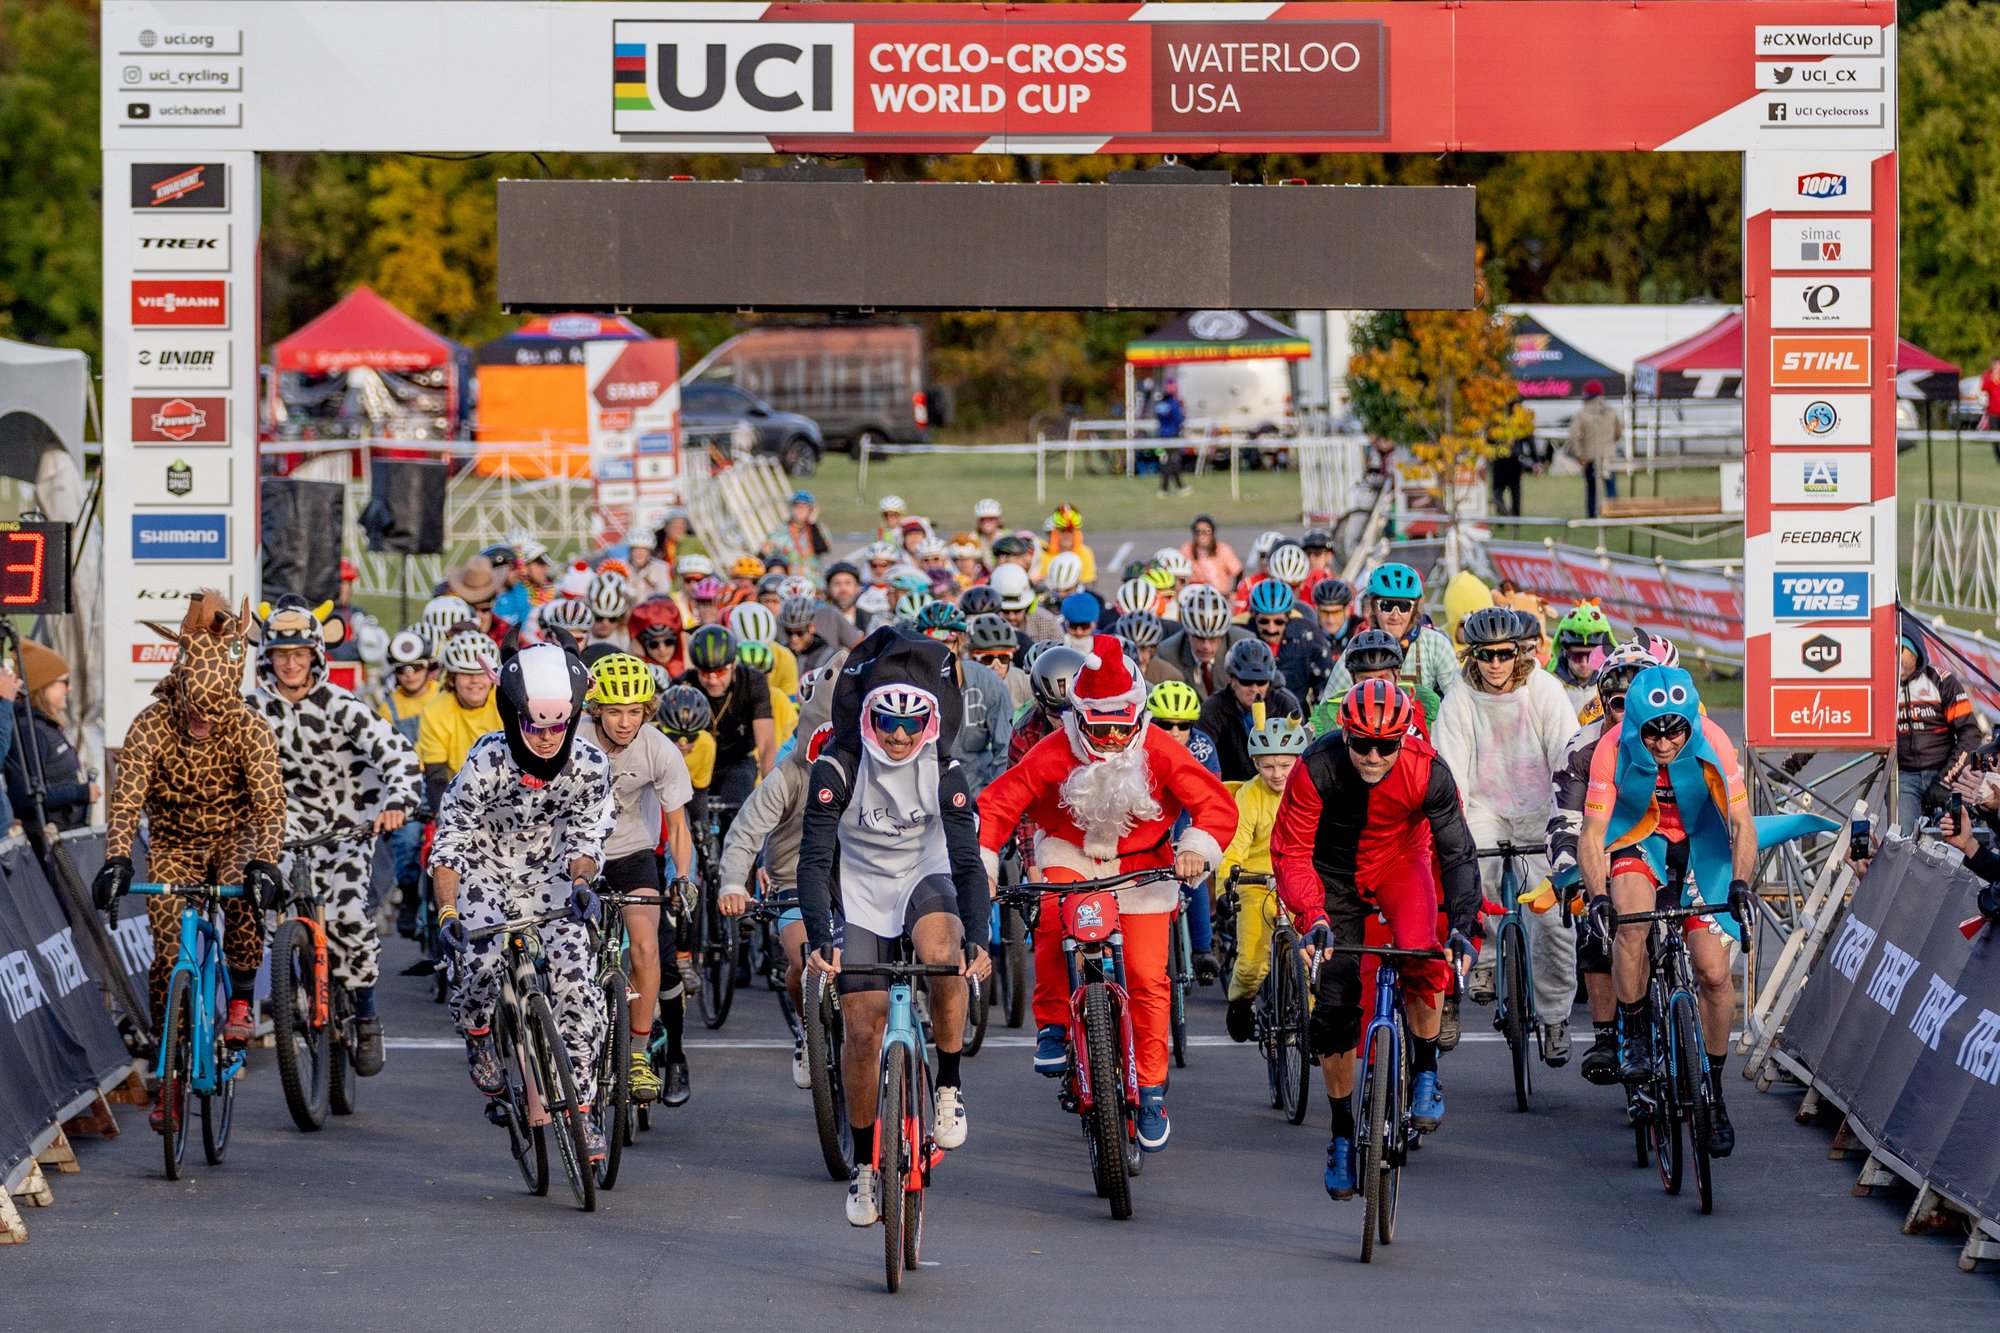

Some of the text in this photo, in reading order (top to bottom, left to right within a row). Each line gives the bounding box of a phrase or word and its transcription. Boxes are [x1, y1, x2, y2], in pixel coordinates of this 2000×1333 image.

[164, 32, 214, 48] uci.org
[1763, 32, 1873, 49] #CXWorldCup
[869, 43, 1127, 73] CYCLO-CROSS
[1168, 42, 1361, 72] WATERLOO
[149, 68, 229, 84] uci_cycling
[657, 43, 833, 112] UCI
[1802, 69, 1857, 85] UCI_CX
[870, 83, 1091, 113] WORLD CUP
[1170, 83, 1241, 113] USA
[159, 105, 226, 116] ucichannel
[1795, 106, 1869, 119] UCI Cyclocross
[1801, 176, 1844, 195] 100%
[1801, 227, 1841, 240] simac
[139, 237, 218, 249] TREK
[159, 351, 215, 365] UNIOR
[1781, 352, 1860, 371] STIHL
[139, 530, 219, 544] SHIMANO
[1780, 531, 1862, 544] FEEDBACK
[3, 533, 45, 604] 3
[1782, 578, 1844, 594] TOYO
[1792, 595, 1859, 611] TIRES
[1805, 646, 1838, 661] GU
[964, 687, 988, 727] B
[1790, 691, 1852, 729] ethias
[1830, 913, 1878, 985] TREK
[36, 926, 90, 998] TREK
[1865, 940, 1921, 1016] TREK
[1908, 972, 1968, 1051] TREK
